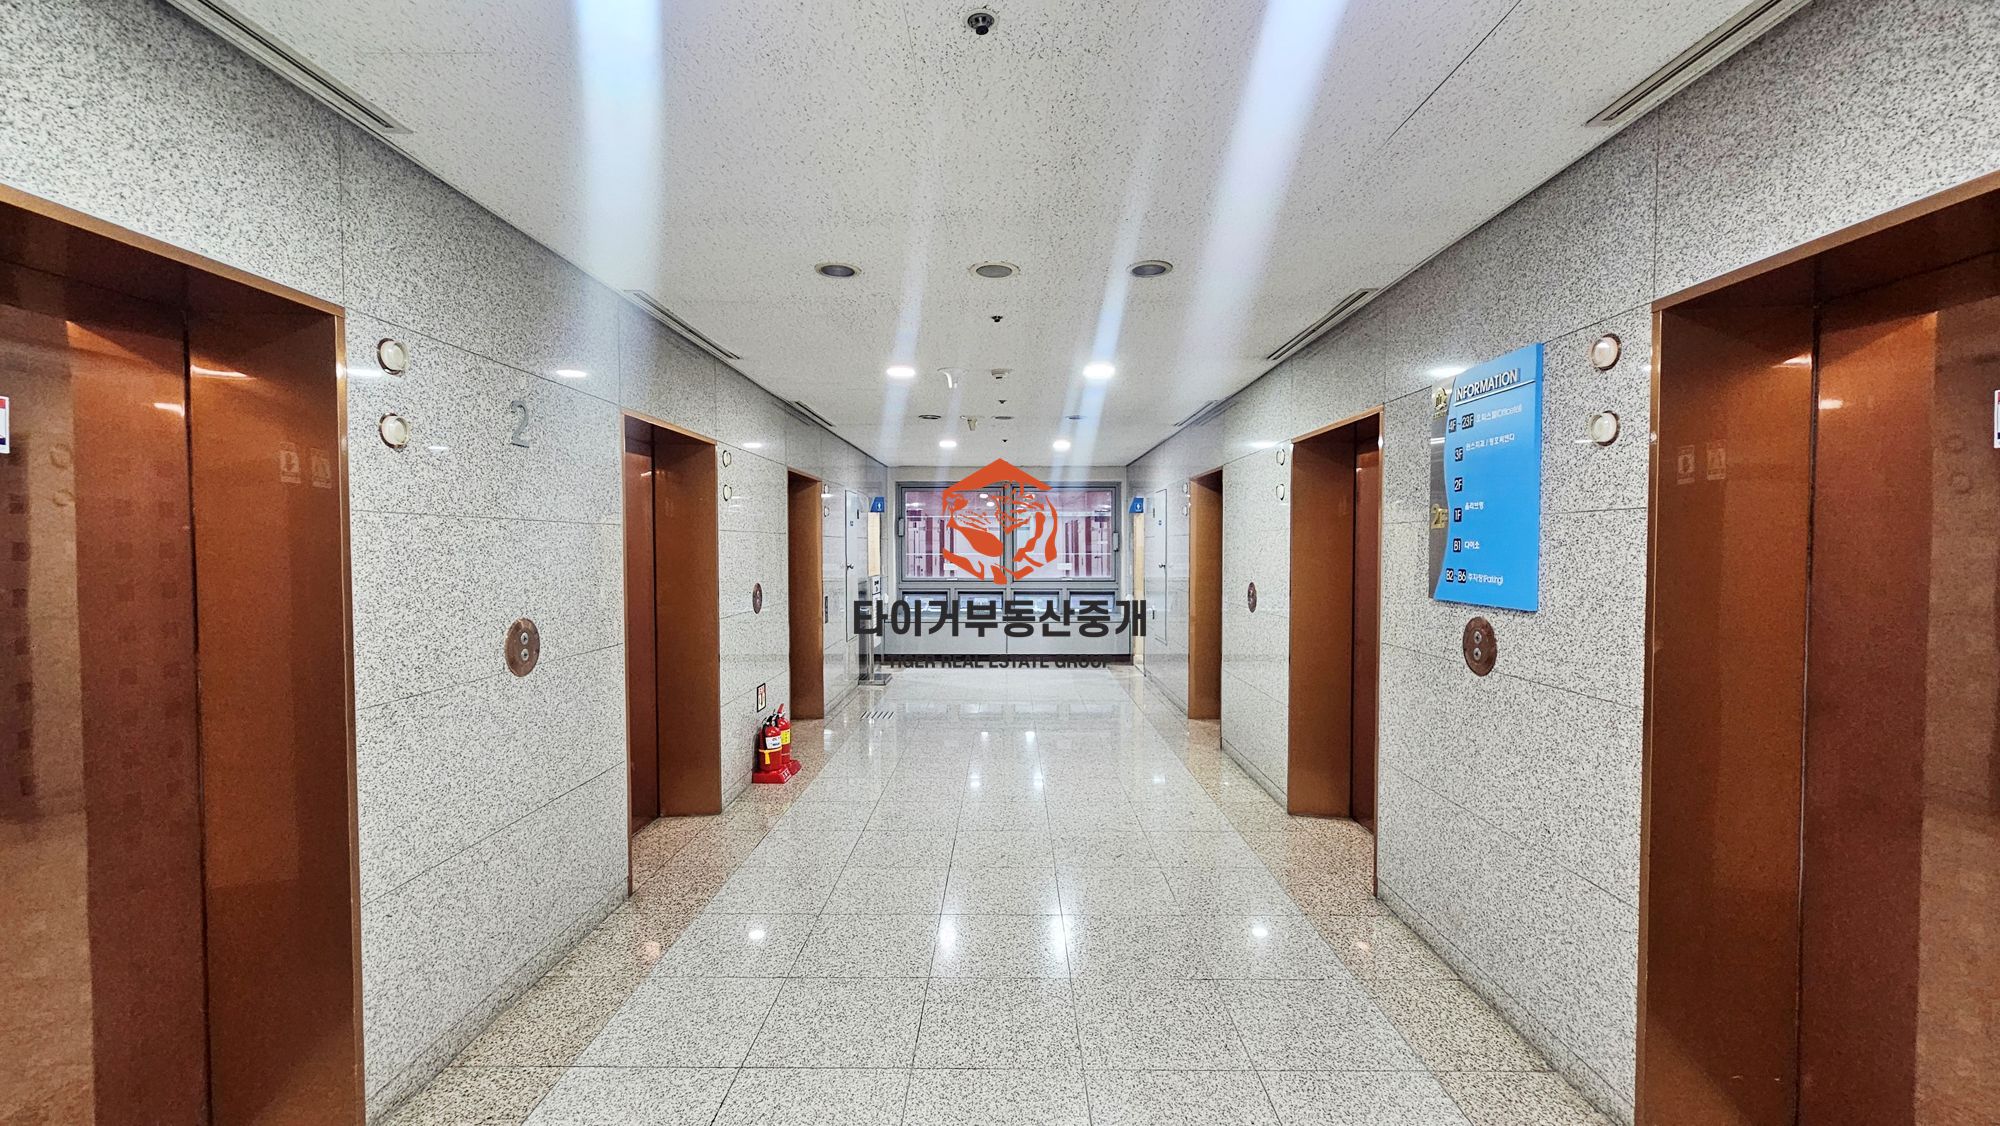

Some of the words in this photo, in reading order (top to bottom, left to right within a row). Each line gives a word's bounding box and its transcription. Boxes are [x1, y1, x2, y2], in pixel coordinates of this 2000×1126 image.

[1455, 368, 1518, 402] INFORMATION
[510, 400, 529, 448] 2
[1462, 414, 1474, 428] 23F
[1455, 447, 1463, 461] 3F
[1454, 478, 1462, 491] 2F
[1454, 509, 1462, 521] 1F
[1453, 540, 1461, 551] B1
